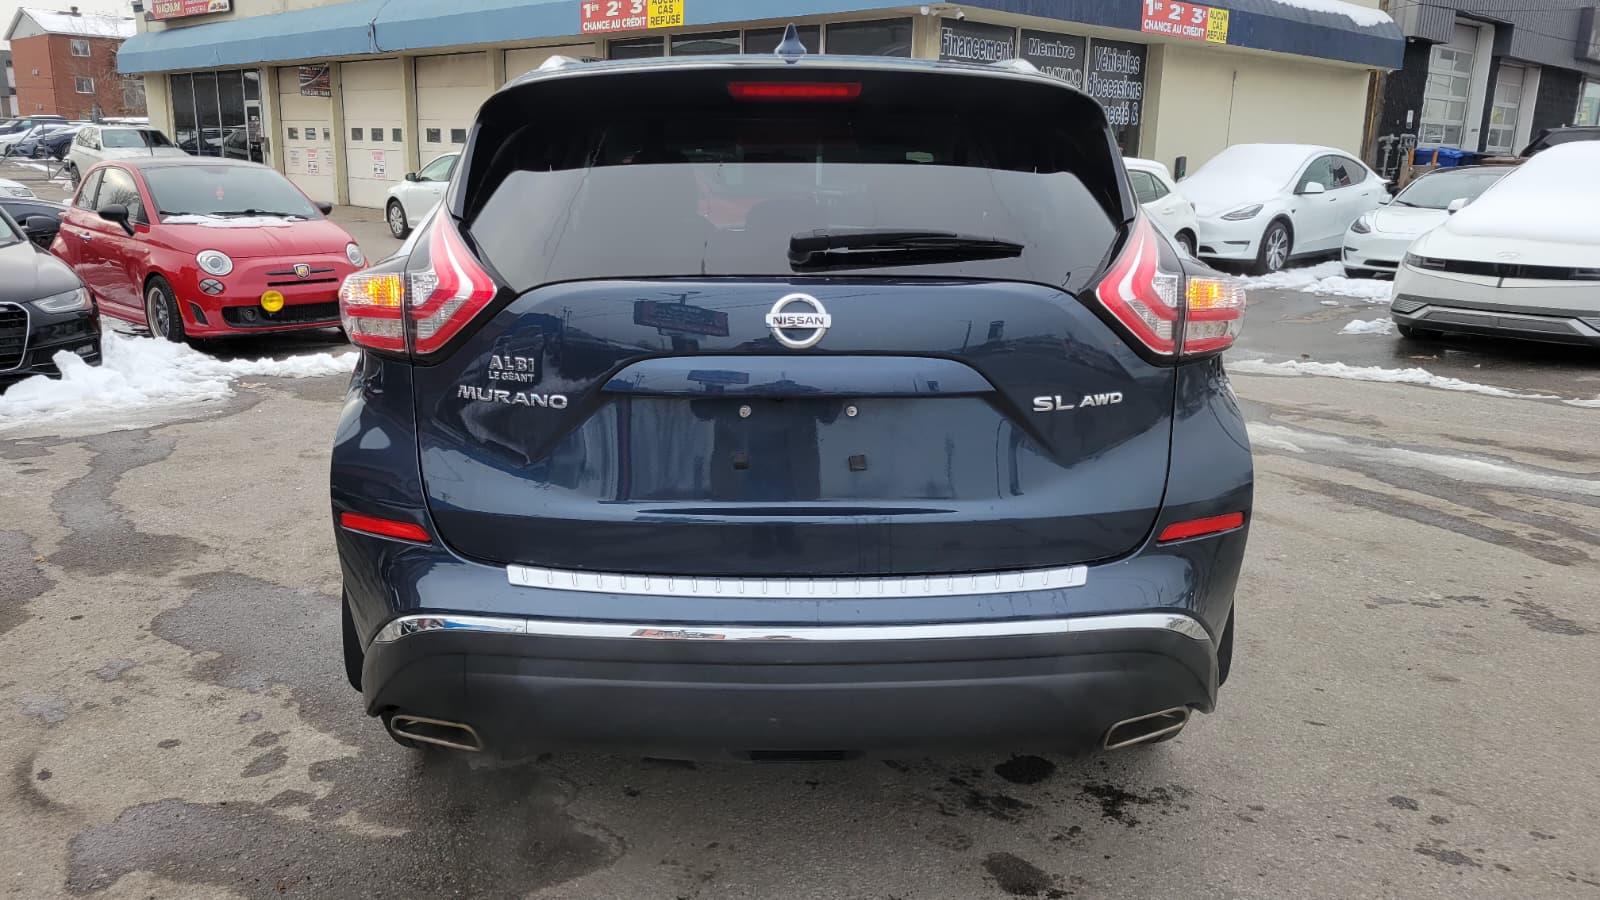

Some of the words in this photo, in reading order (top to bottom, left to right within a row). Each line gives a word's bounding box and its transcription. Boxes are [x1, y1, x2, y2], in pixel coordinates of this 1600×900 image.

[658, 5, 673, 14] CAS
[583, 20, 610, 31] CHANCE
[611, 18, 621, 29] AU
[622, 15, 646, 28] CRÉDIT
[1144, 19, 1172, 33] CHANCE
[1172, 23, 1181, 34] AU
[1182, 24, 1204, 37] CRÉDIT
[1212, 21, 1223, 31] CAS
[941, 27, 1014, 62] Financement
[1028, 38, 1076, 59] Membre
[1094, 45, 1140, 75] Véhicules
[1088, 72, 1142, 100] d'occasions
[1131, 101, 1139, 125] &
[773, 316, 824, 326] NISSAN
[488, 355, 535, 372] ALBI
[488, 370, 500, 380] LE
[457, 384, 568, 409] MURANO
[1033, 394, 1075, 412] SL
[1079, 392, 1123, 408] AWD
